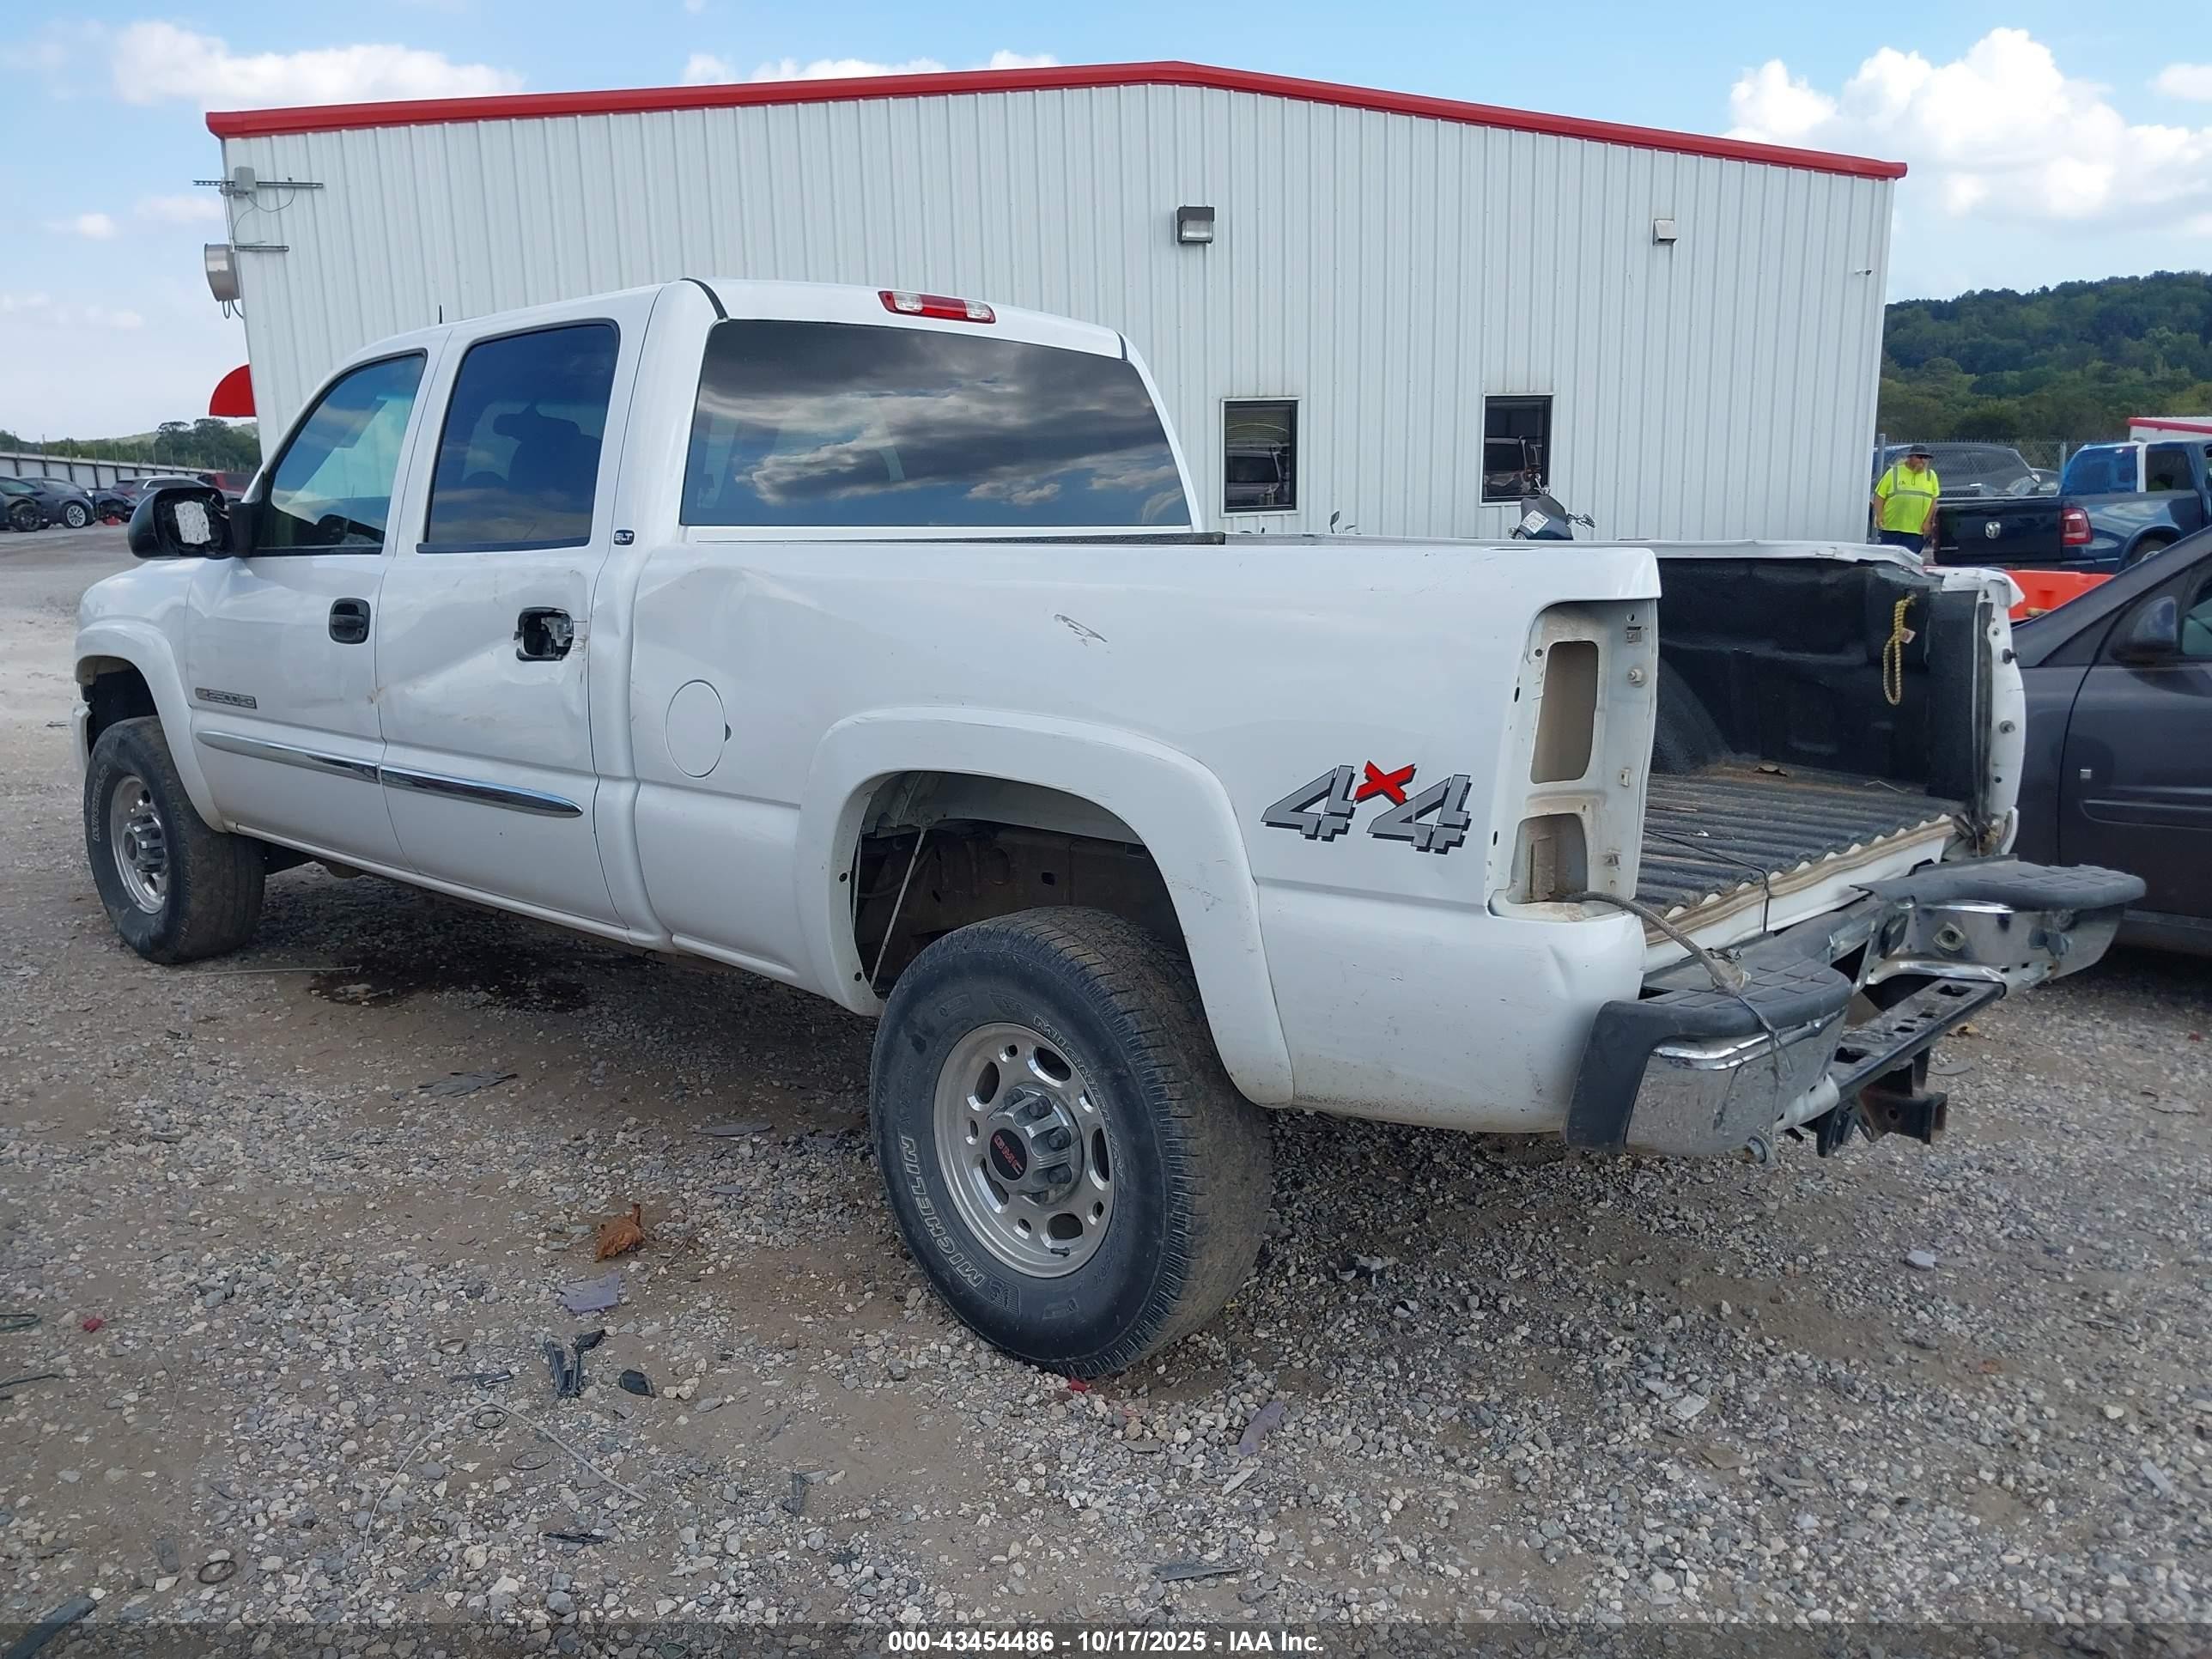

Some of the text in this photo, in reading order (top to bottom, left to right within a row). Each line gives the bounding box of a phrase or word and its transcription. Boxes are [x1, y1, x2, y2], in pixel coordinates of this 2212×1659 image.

[615, 532, 633, 541] SLT
[1033, 1015, 1125, 1178] MICHELIN
[994, 1134, 1024, 1176] GMC
[900, 1135, 986, 1287] MICHELIN
